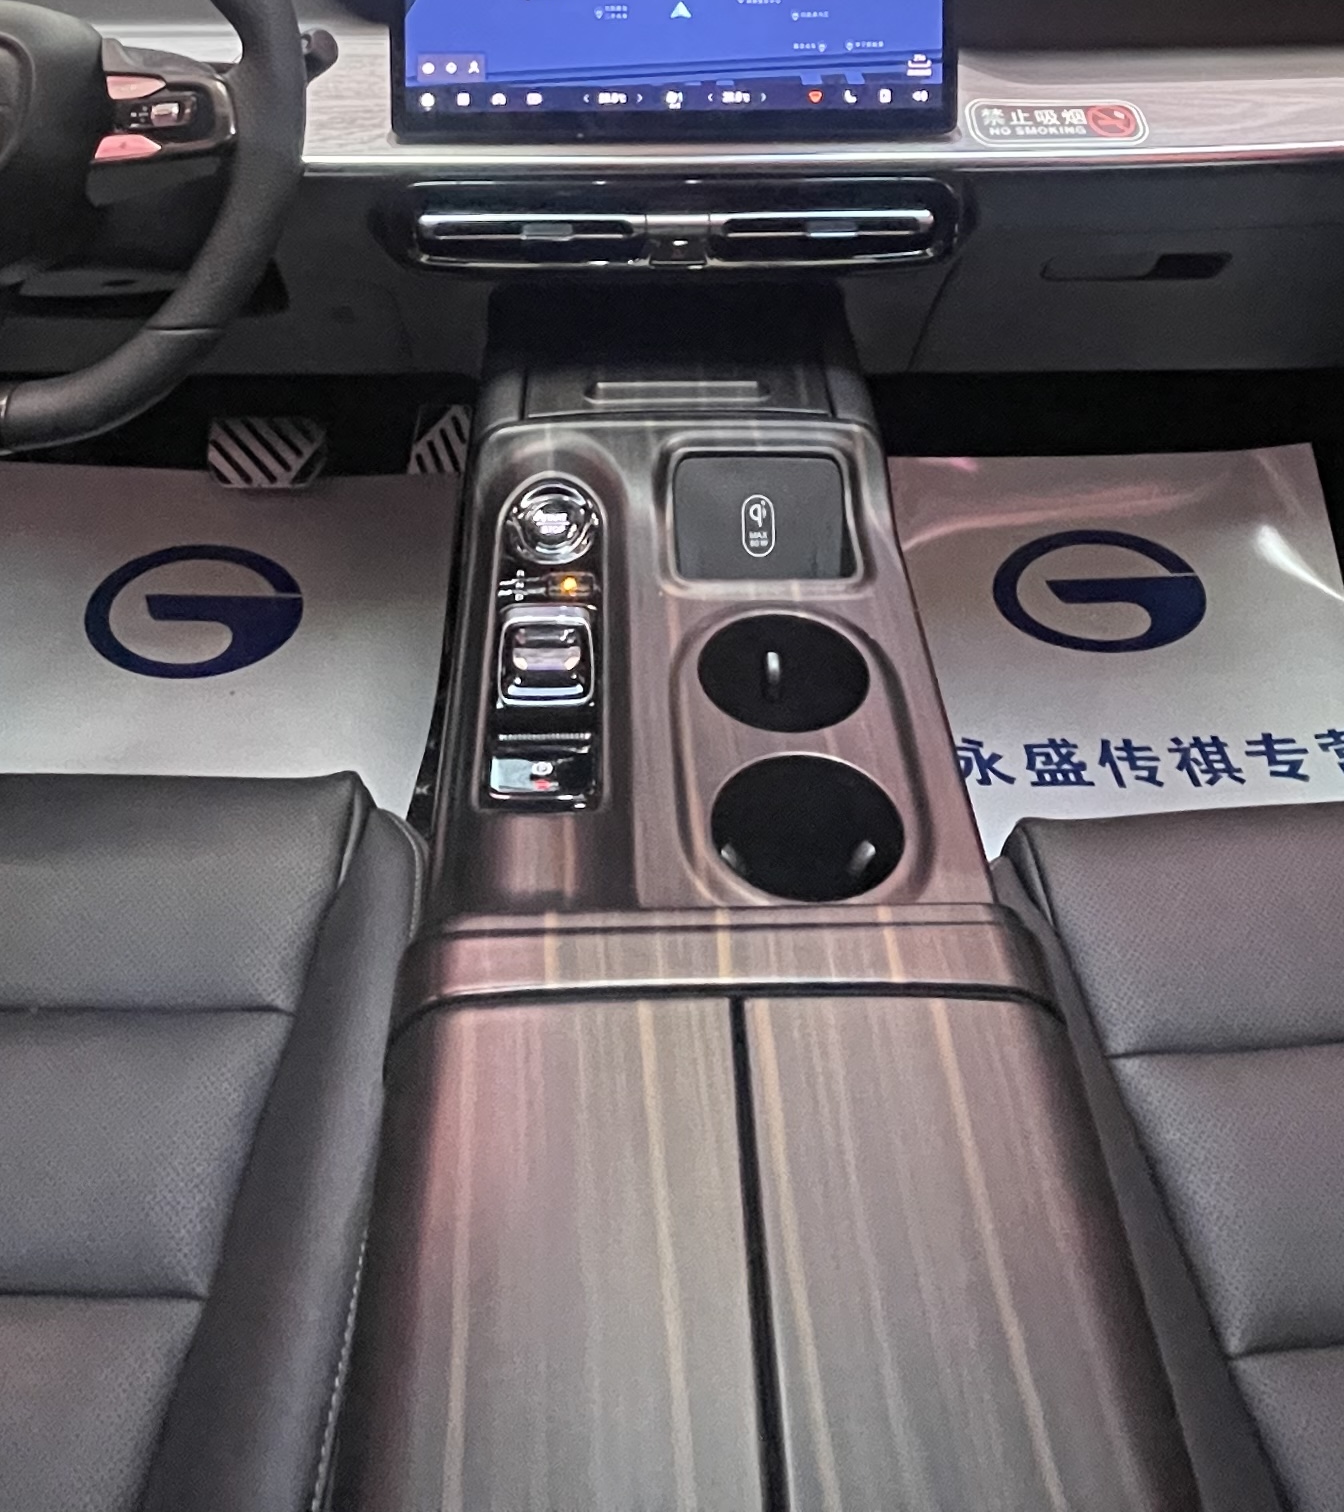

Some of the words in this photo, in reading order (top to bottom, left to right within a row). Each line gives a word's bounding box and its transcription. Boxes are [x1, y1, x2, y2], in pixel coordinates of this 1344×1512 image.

[981, 107, 1088, 126] 禁止吸烟
[989, 126, 1012, 136] NO
[1015, 125, 1087, 136] SMOKING
